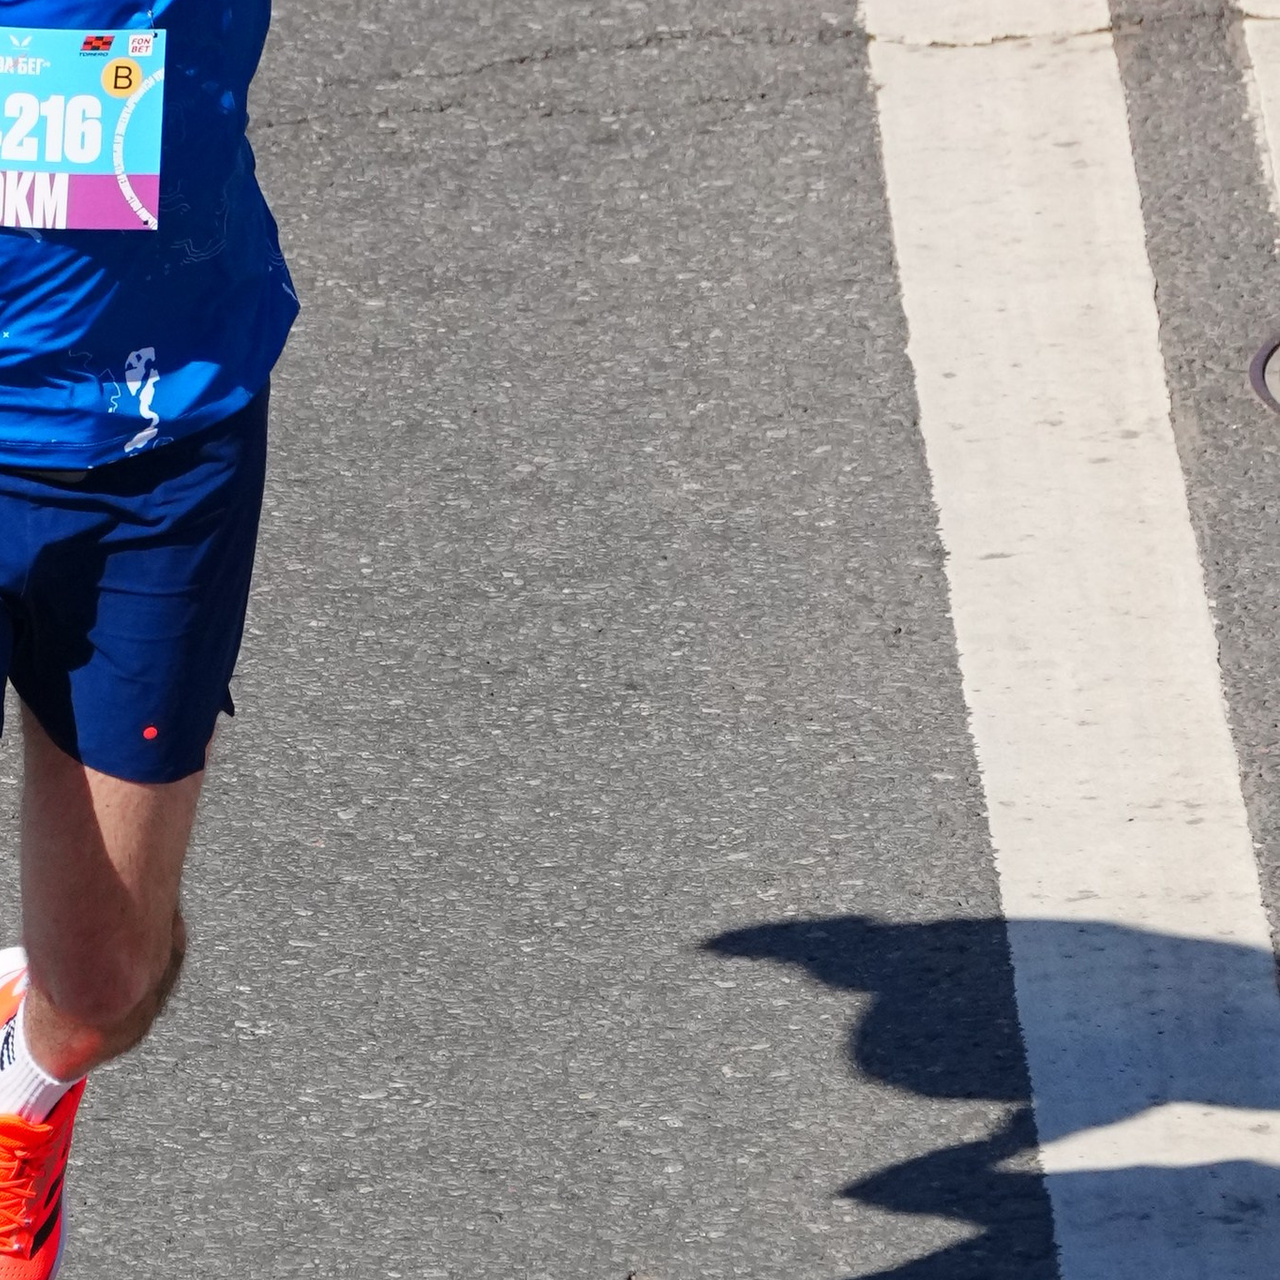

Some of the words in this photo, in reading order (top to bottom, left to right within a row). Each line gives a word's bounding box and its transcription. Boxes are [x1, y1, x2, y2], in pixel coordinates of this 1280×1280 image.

[130, 37, 151, 46] FON
[130, 45, 151, 54] BET
[113, 65, 133, 90] B
